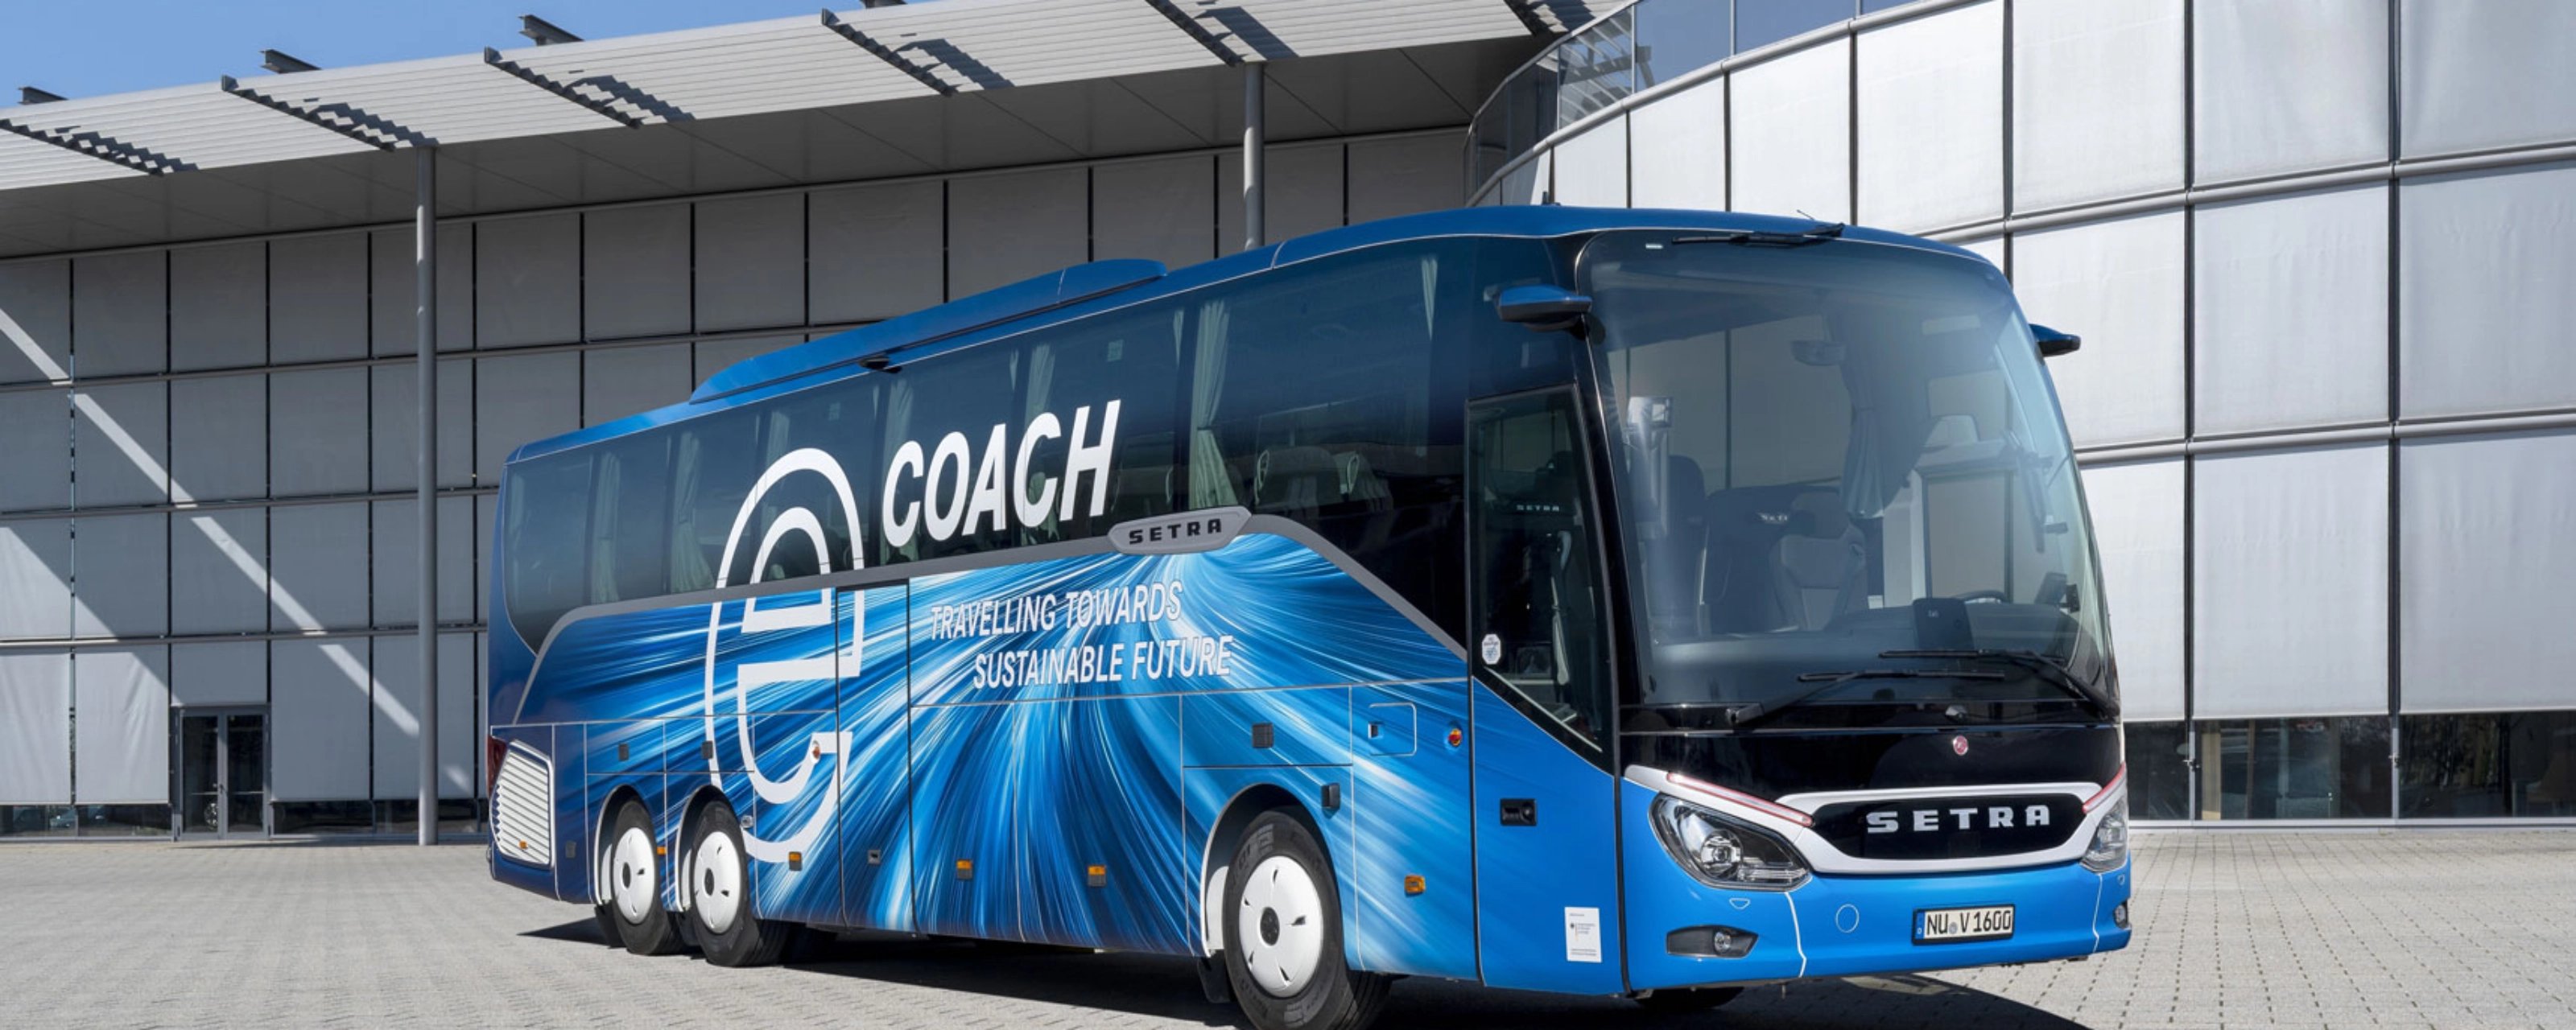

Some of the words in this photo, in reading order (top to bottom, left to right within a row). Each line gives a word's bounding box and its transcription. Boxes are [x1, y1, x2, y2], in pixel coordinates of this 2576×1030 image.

[882, 399, 1121, 548] COACH
[1129, 518, 1222, 545] SETRA
[930, 593, 1057, 641] TRAVELLING
[1065, 580, 1183, 629] TOWARDS
[972, 641, 1125, 690] SUSTAINABLE
[1131, 635, 1234, 680] FUTURE
[1865, 804, 2050, 834] SETRA
[1926, 913, 1949, 936] NU
[1972, 909, 2011, 933] 1600
